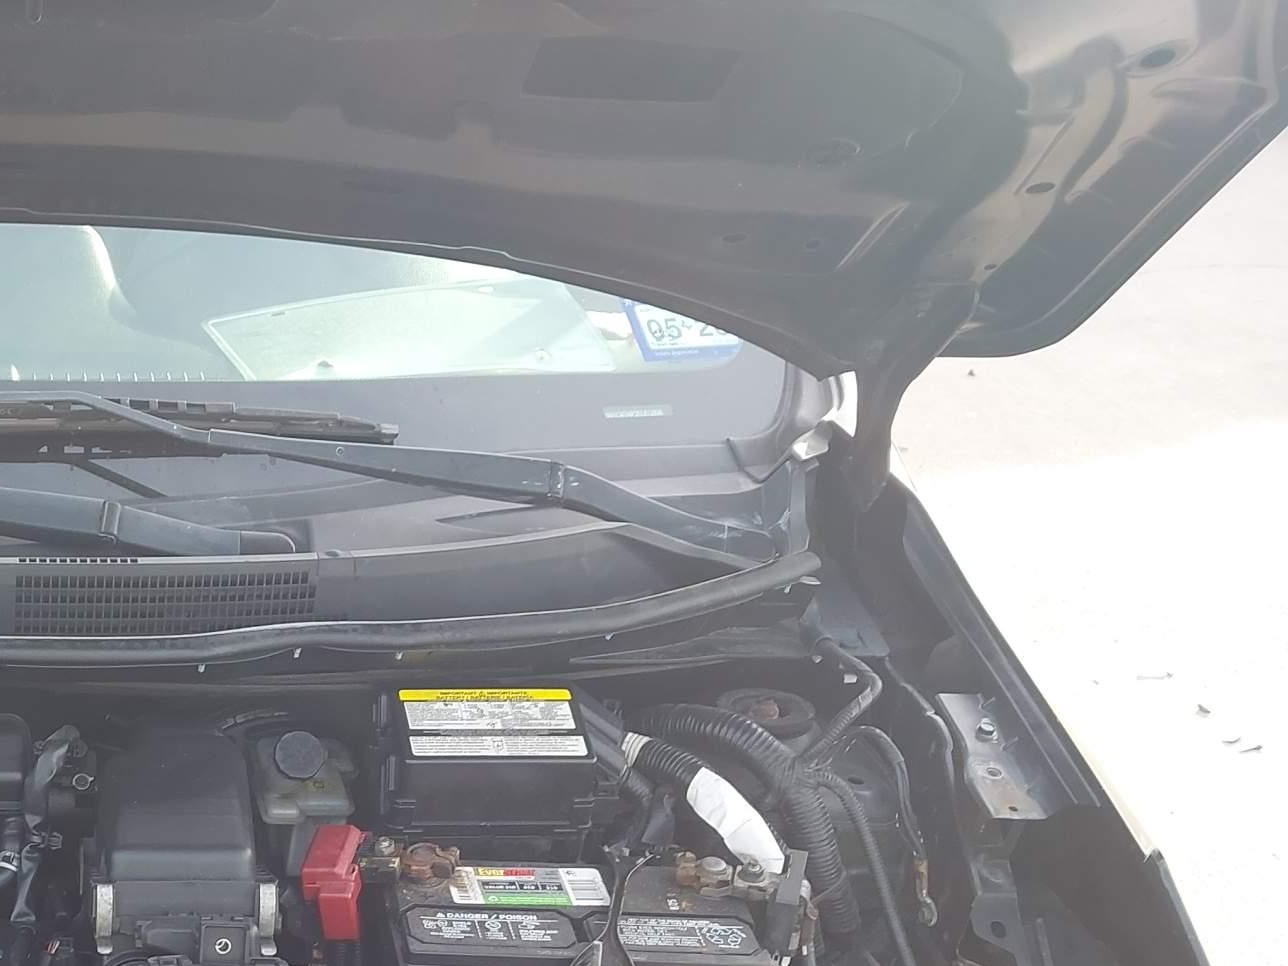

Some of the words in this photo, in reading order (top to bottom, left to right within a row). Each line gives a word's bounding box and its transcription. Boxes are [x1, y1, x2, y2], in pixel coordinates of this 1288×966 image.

[647, 318, 682, 342] 05
[446, 912, 489, 920] DANGER
[499, 913, 538, 922] POISON
